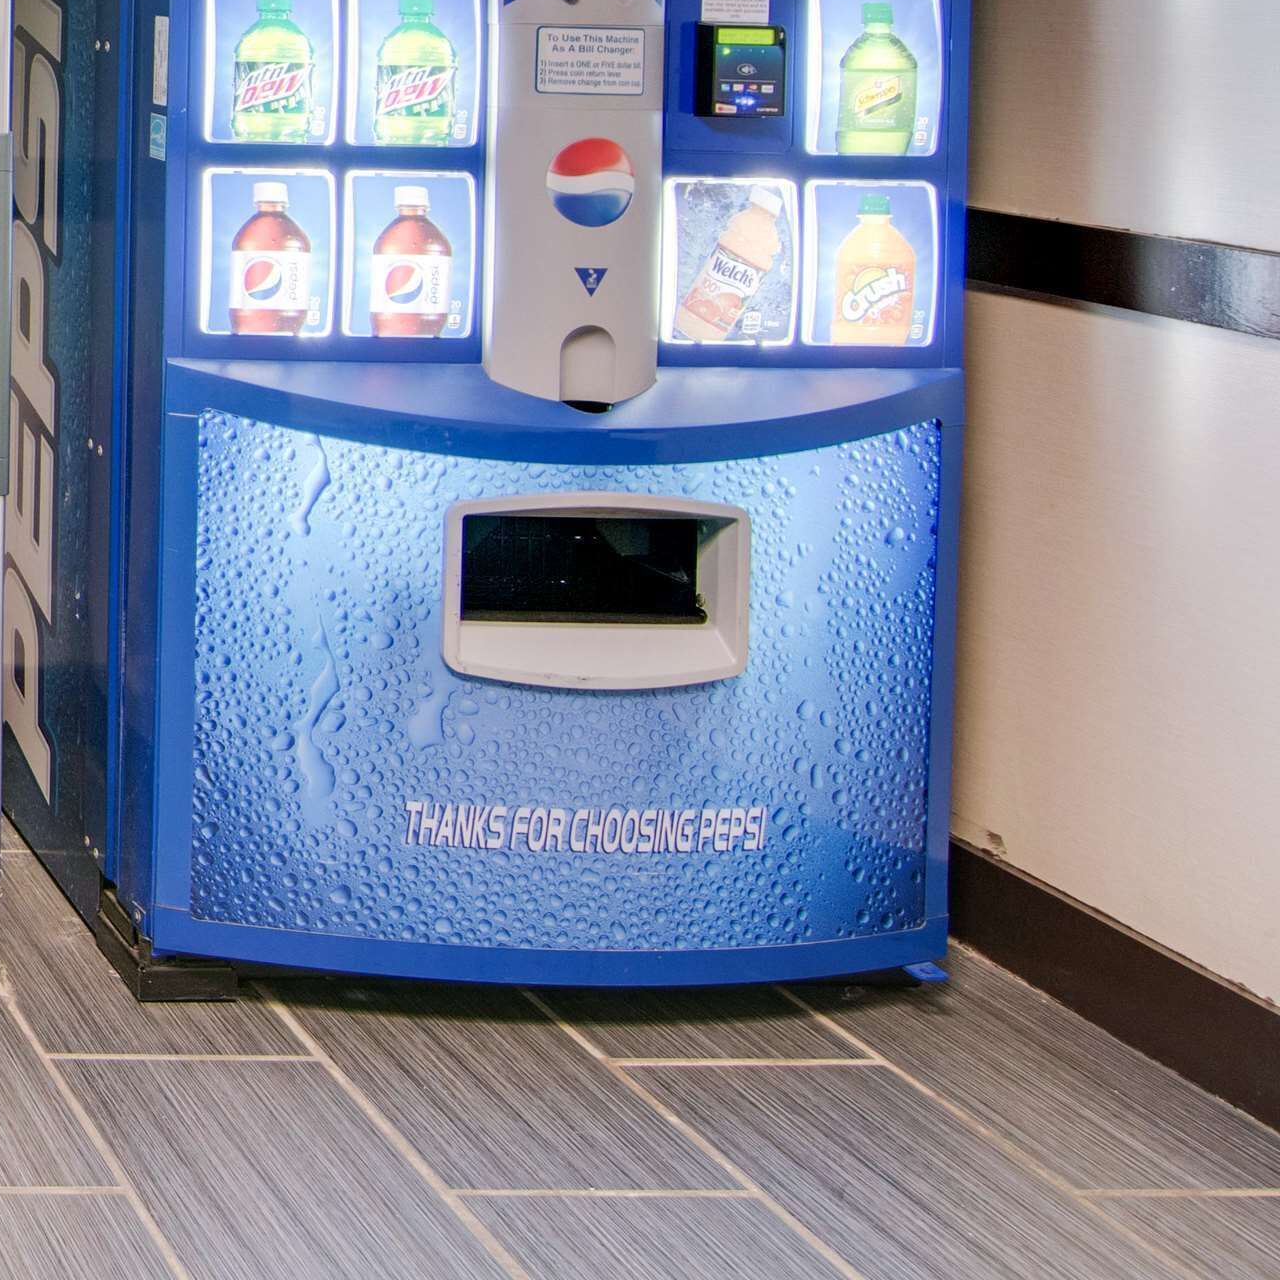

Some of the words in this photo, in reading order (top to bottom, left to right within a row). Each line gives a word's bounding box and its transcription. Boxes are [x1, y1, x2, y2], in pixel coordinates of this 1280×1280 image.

[547, 33, 559, 42] To
[561, 33, 582, 43] Use
[583, 34, 603, 44] This
[605, 34, 640, 45] Machine
[551, 43, 566, 53] As
[568, 43, 576, 53] A
[578, 44, 594, 54] Bill
[547, 59, 569, 69] Insert
[575, 60, 591, 69] ONE
[601, 60, 616, 70] FIVE
[547, 69, 568, 78] Press
[569, 69, 585, 78] coin
[585, 70, 606, 79] return
[547, 77, 576, 86] Remove
[577, 78, 602, 88] change
[603, 78, 617, 87] from
[711, 255, 755, 289] Welch's
[841, 266, 909, 322] Crush
[404, 800, 508, 850] THANKS
[509, 806, 565, 854] FOR
[568, 806, 696, 855] CHOOSING
[696, 805, 770, 853] PEPSI
